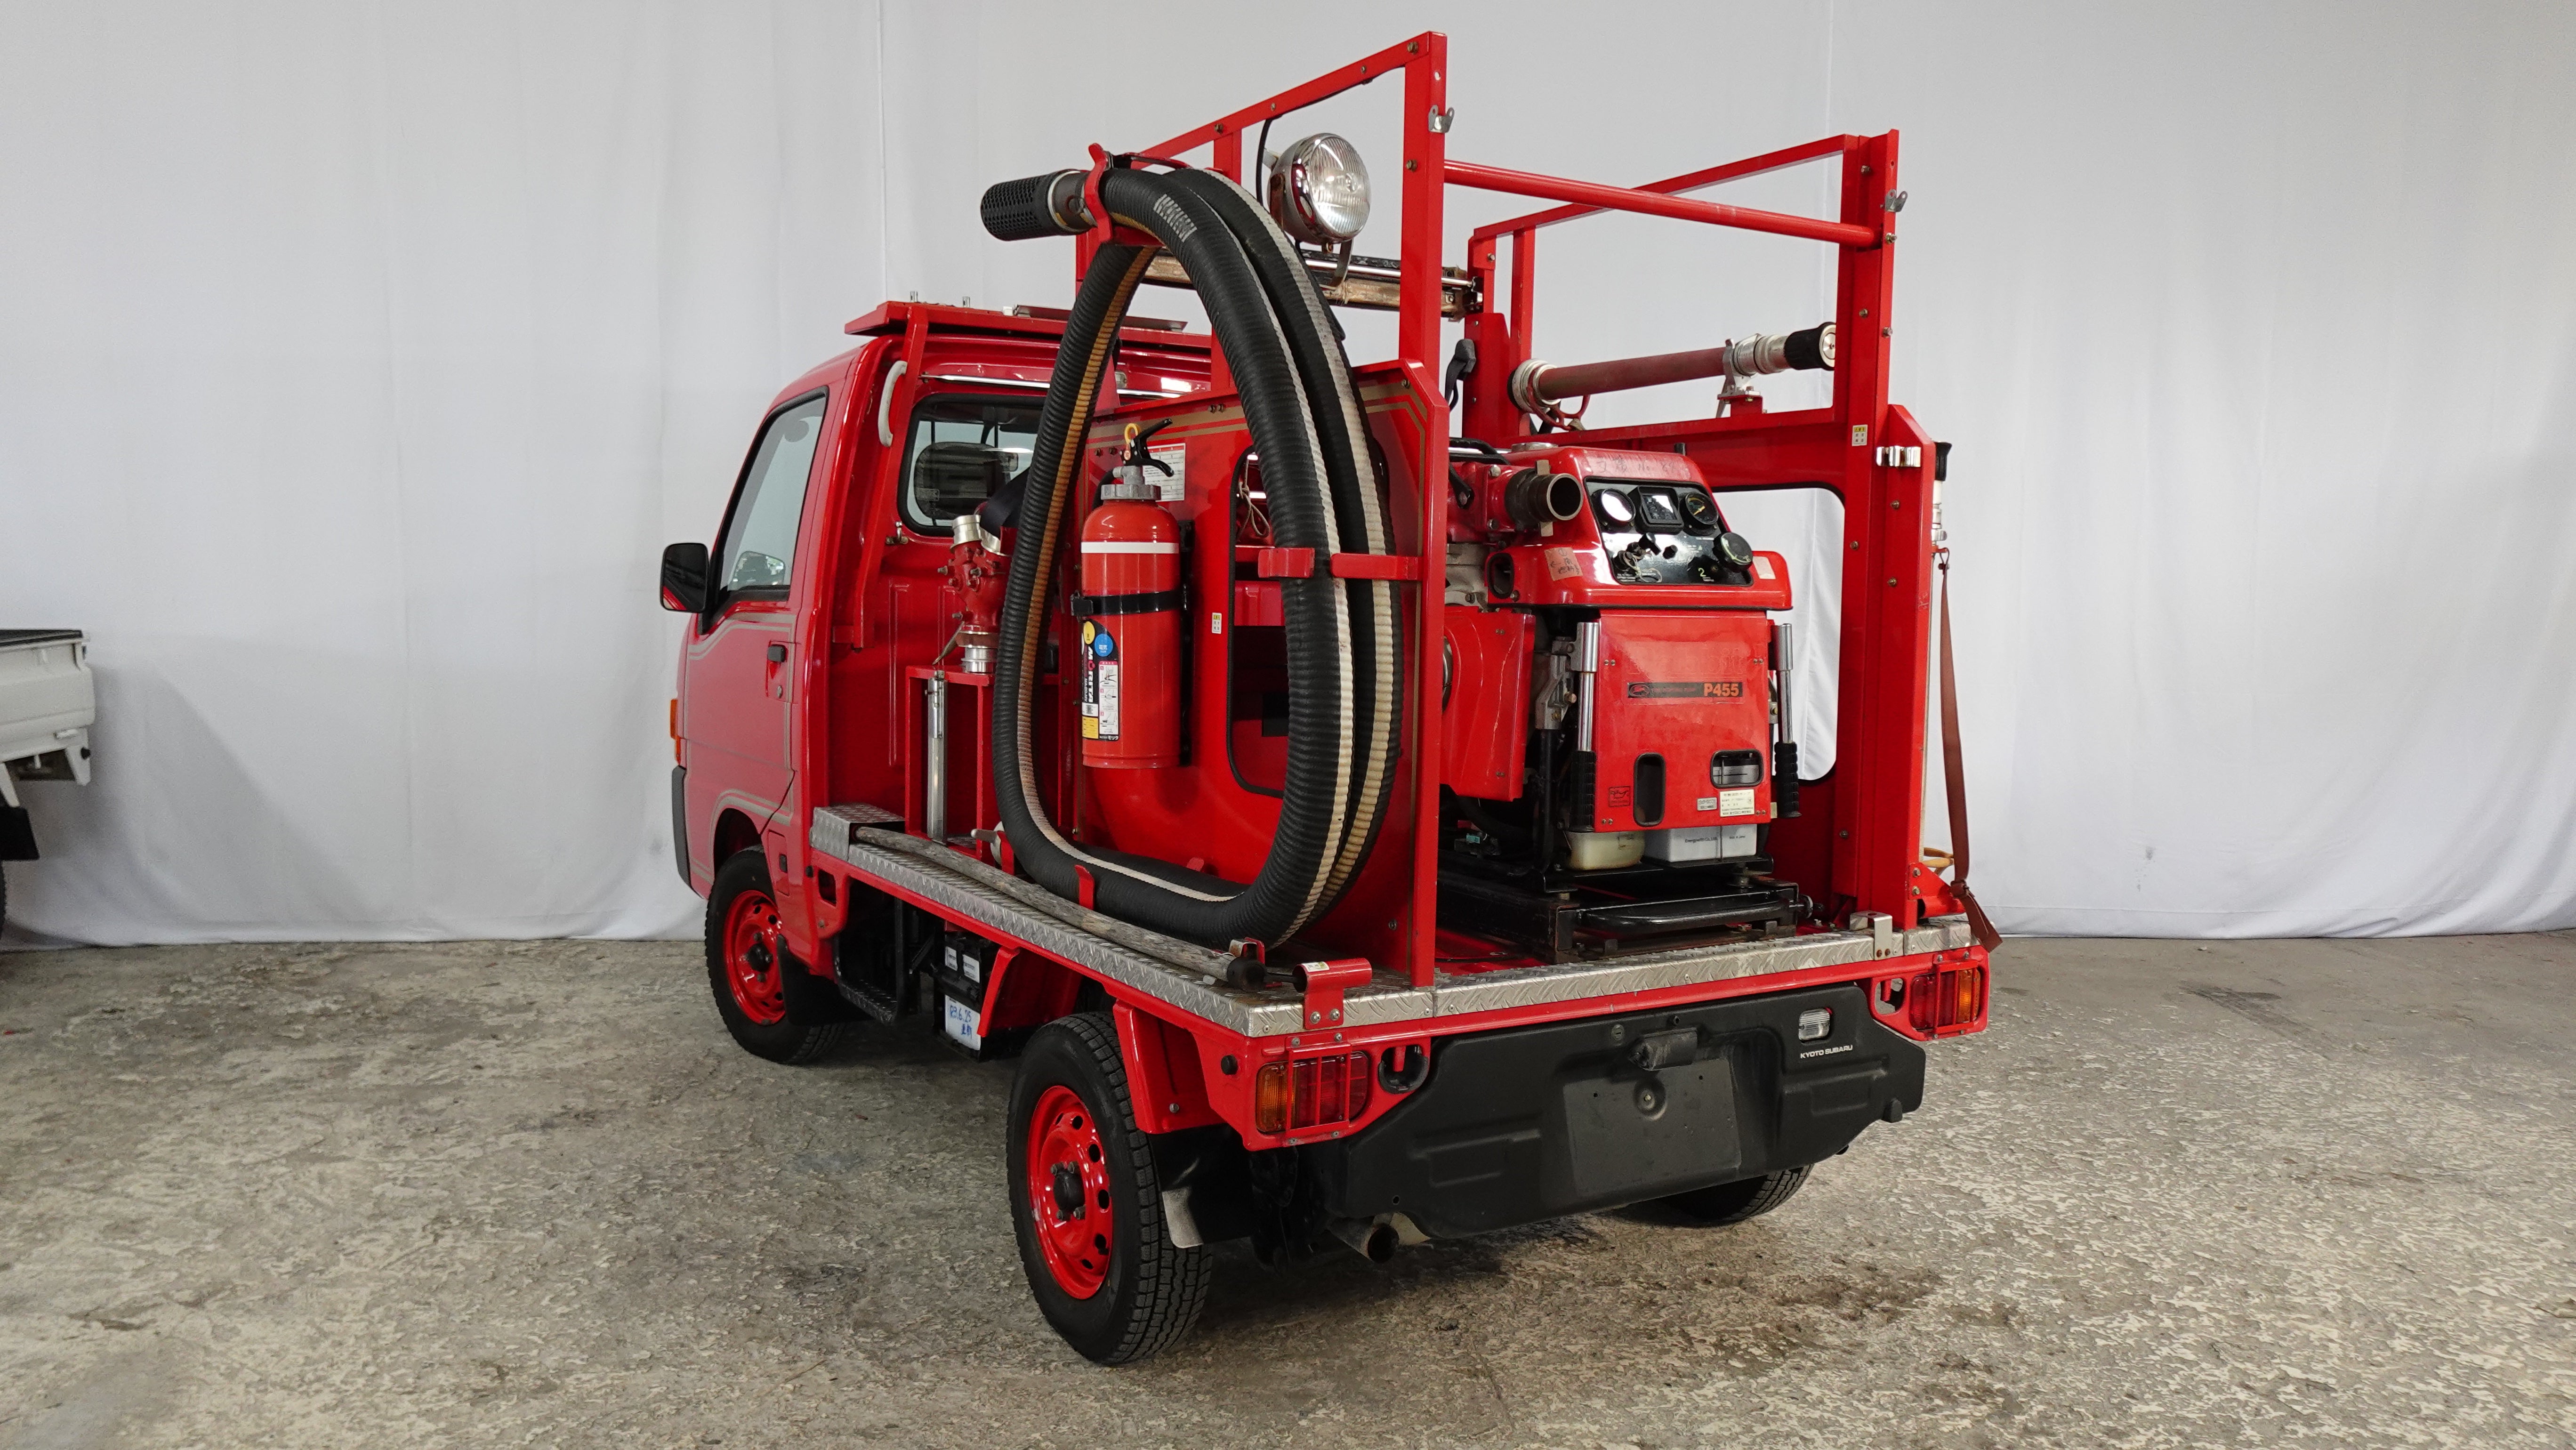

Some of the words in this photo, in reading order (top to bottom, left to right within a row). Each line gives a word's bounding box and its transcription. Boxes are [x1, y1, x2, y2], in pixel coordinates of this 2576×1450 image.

[1703, 683, 1739, 697] P455
[1800, 1050, 1824, 1059] KYOTO
[1825, 1045, 1853, 1055] SUBARU
